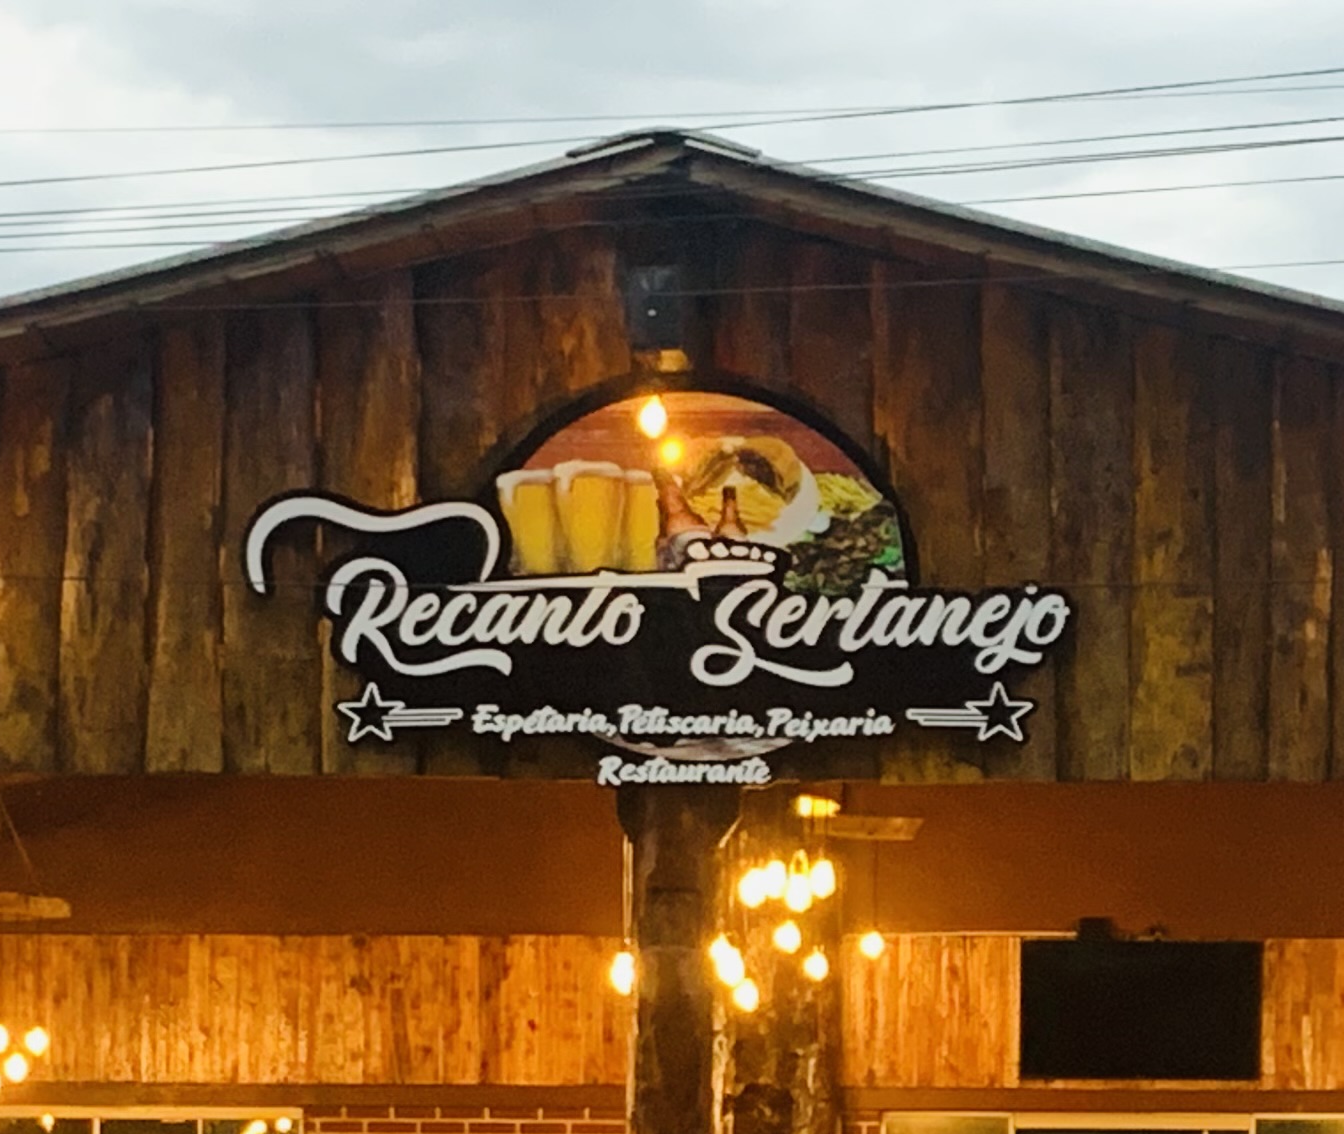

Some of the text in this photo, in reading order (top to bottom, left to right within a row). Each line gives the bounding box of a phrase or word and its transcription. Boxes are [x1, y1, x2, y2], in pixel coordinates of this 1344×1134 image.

[327, 557, 1070, 687] Recanto Sertanejo
[767, 708, 894, 742] Peixaria
[597, 756, 772, 786] Restaurante
